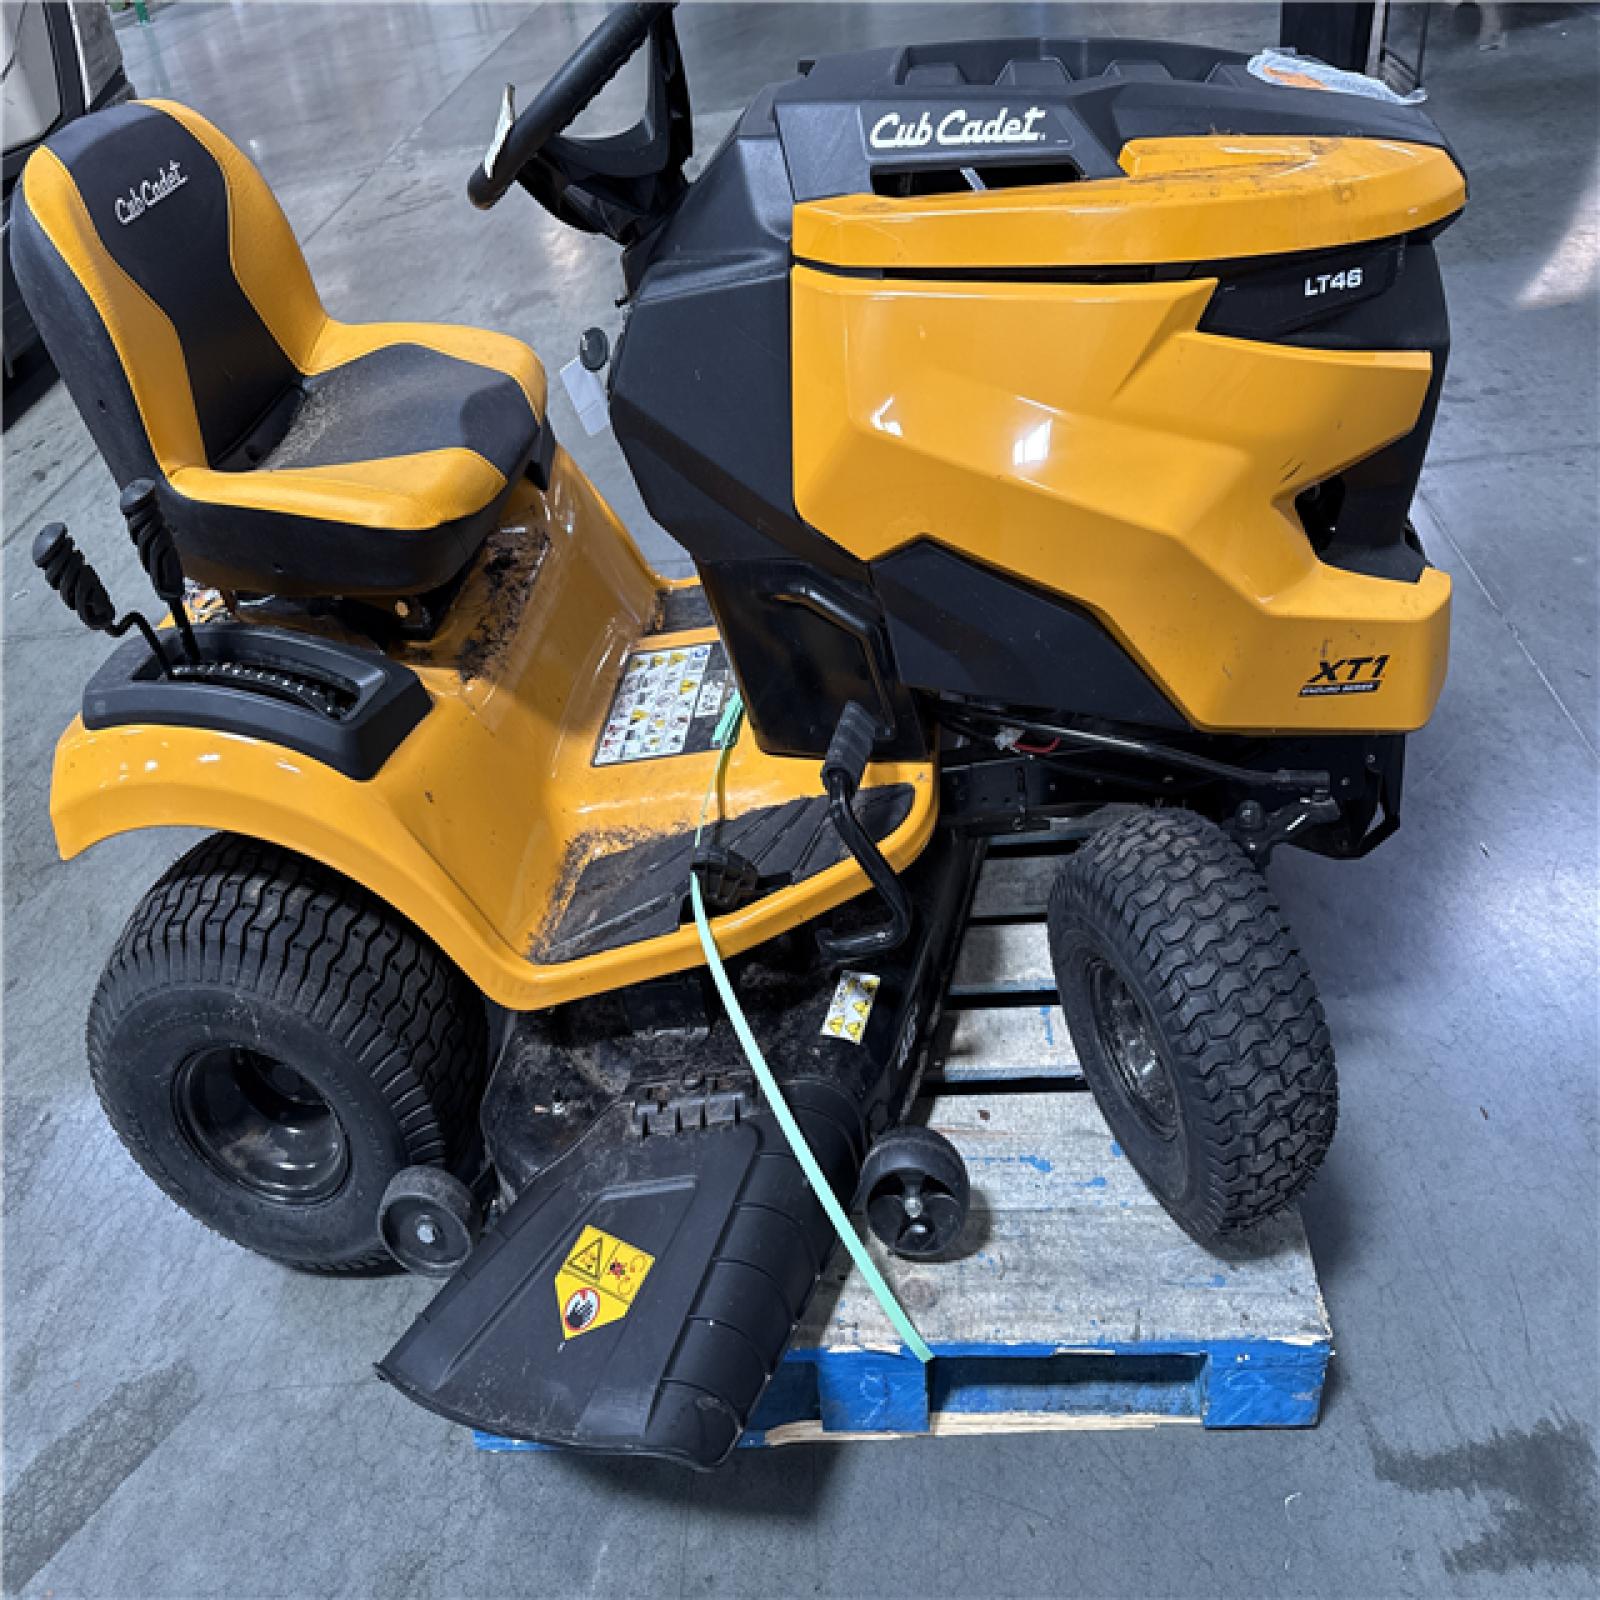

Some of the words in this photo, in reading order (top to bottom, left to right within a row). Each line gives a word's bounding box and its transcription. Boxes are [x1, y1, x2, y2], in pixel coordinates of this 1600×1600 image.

[870, 112, 933, 148] Cub
[936, 106, 1046, 145] Cadet
[114, 187, 146, 225] Cub
[1304, 267, 1363, 297] LT46
[1307, 655, 1390, 683] XT1
